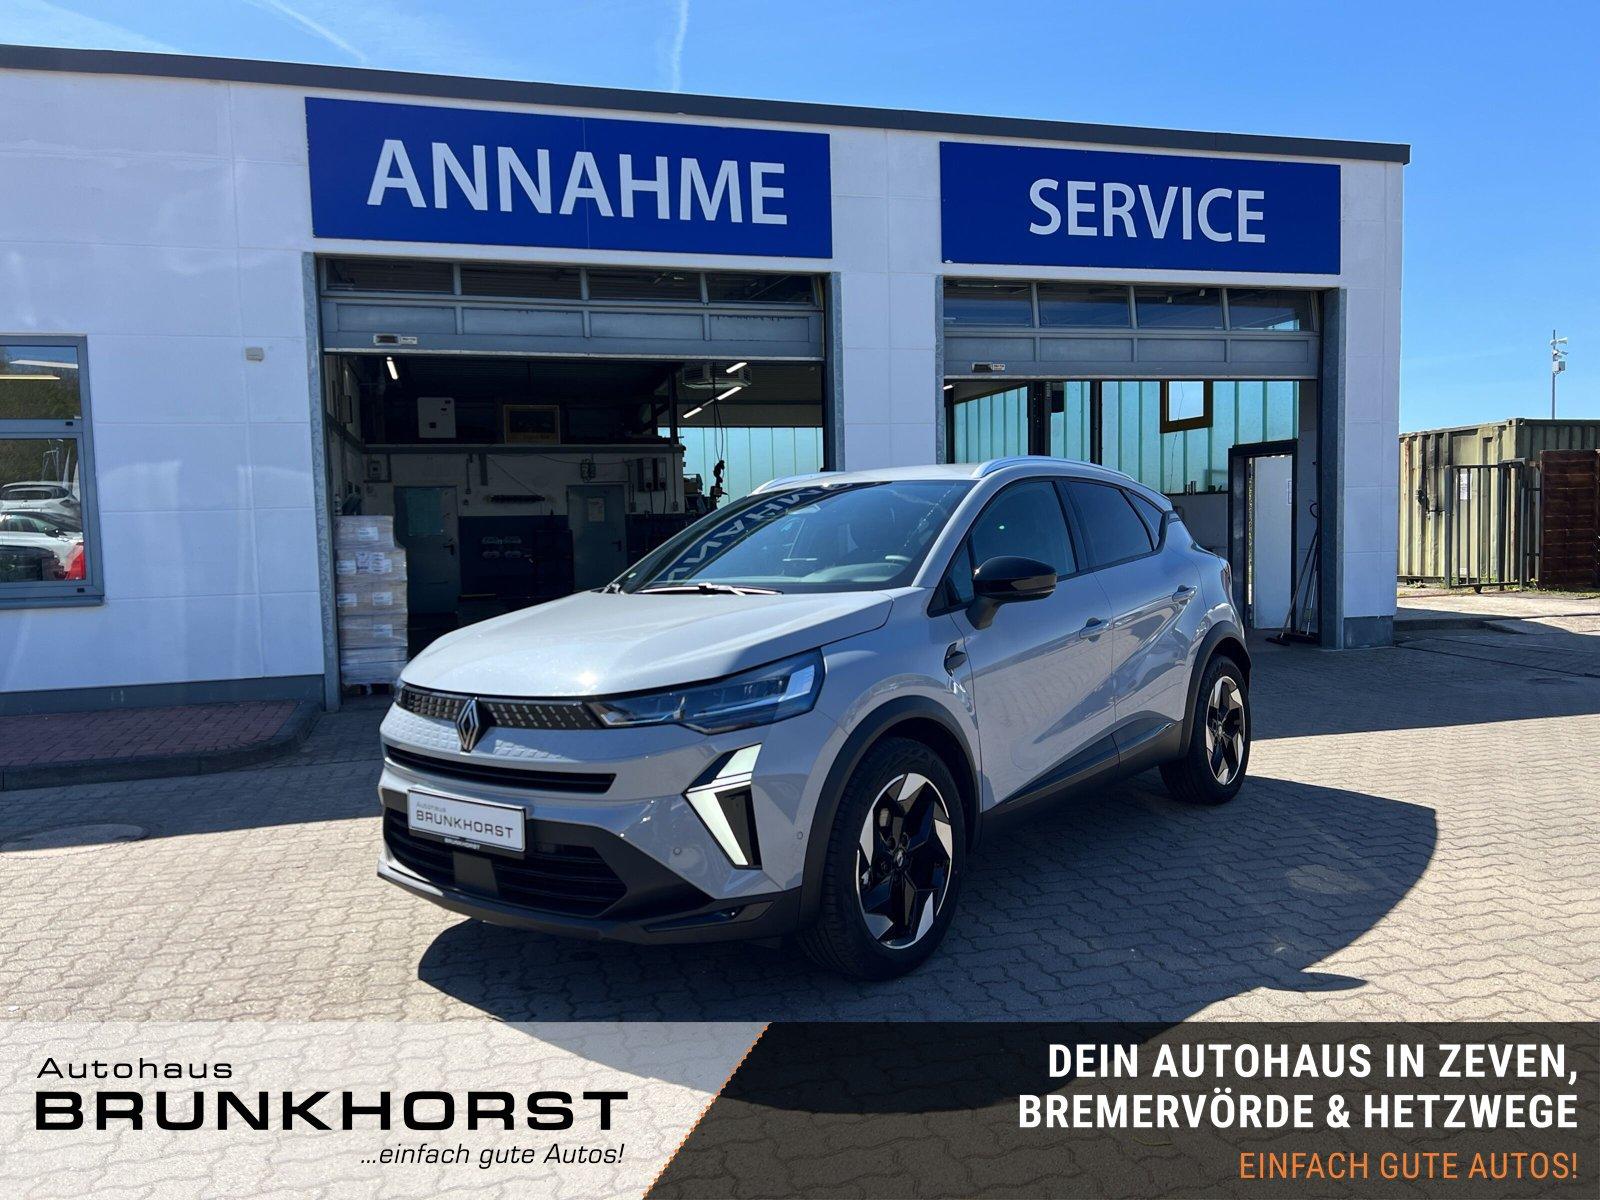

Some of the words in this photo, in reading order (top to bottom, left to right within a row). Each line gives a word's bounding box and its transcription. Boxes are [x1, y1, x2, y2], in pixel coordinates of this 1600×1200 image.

[367, 138, 789, 227] ANNAHME
[1029, 178, 1267, 244] SERVICE
[416, 809, 515, 839] BRUNKHORST
